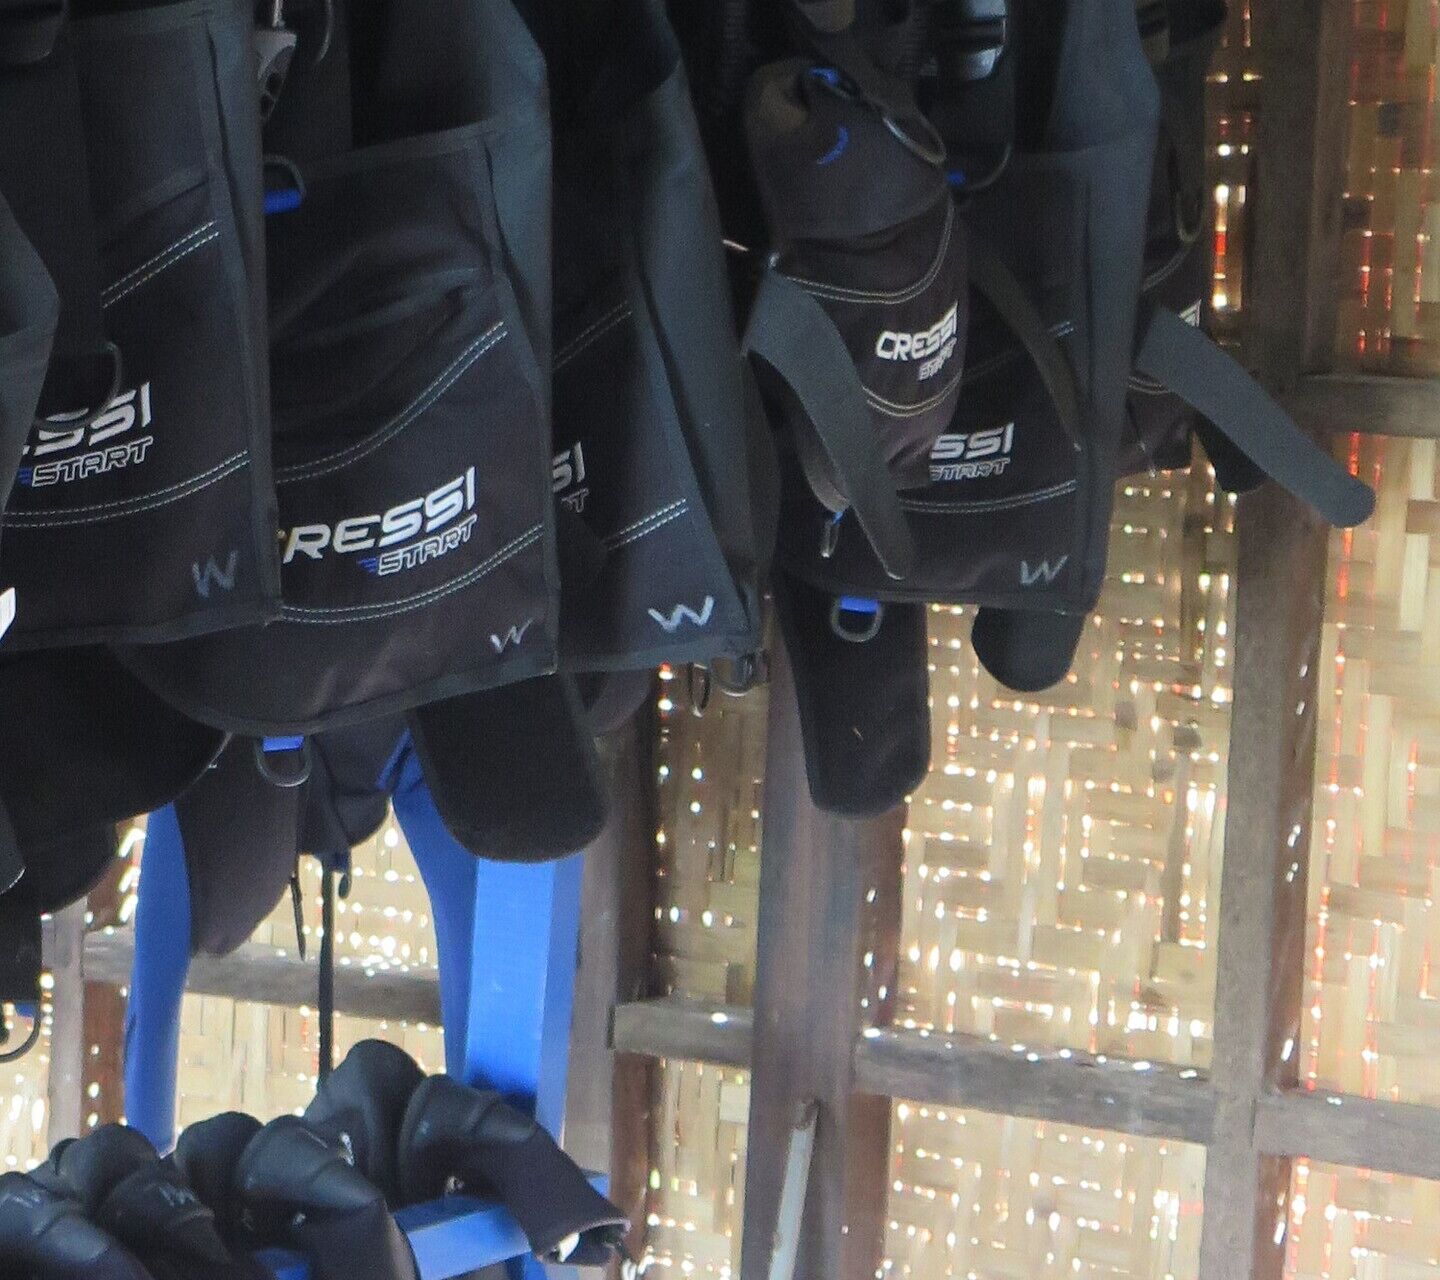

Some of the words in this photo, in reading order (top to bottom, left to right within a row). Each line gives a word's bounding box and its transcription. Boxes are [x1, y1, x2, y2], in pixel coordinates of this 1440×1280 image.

[875, 299, 959, 361] CRESSI
[31, 435, 154, 488] START
[282, 465, 476, 565] RESSI
[377, 513, 478, 576] START
